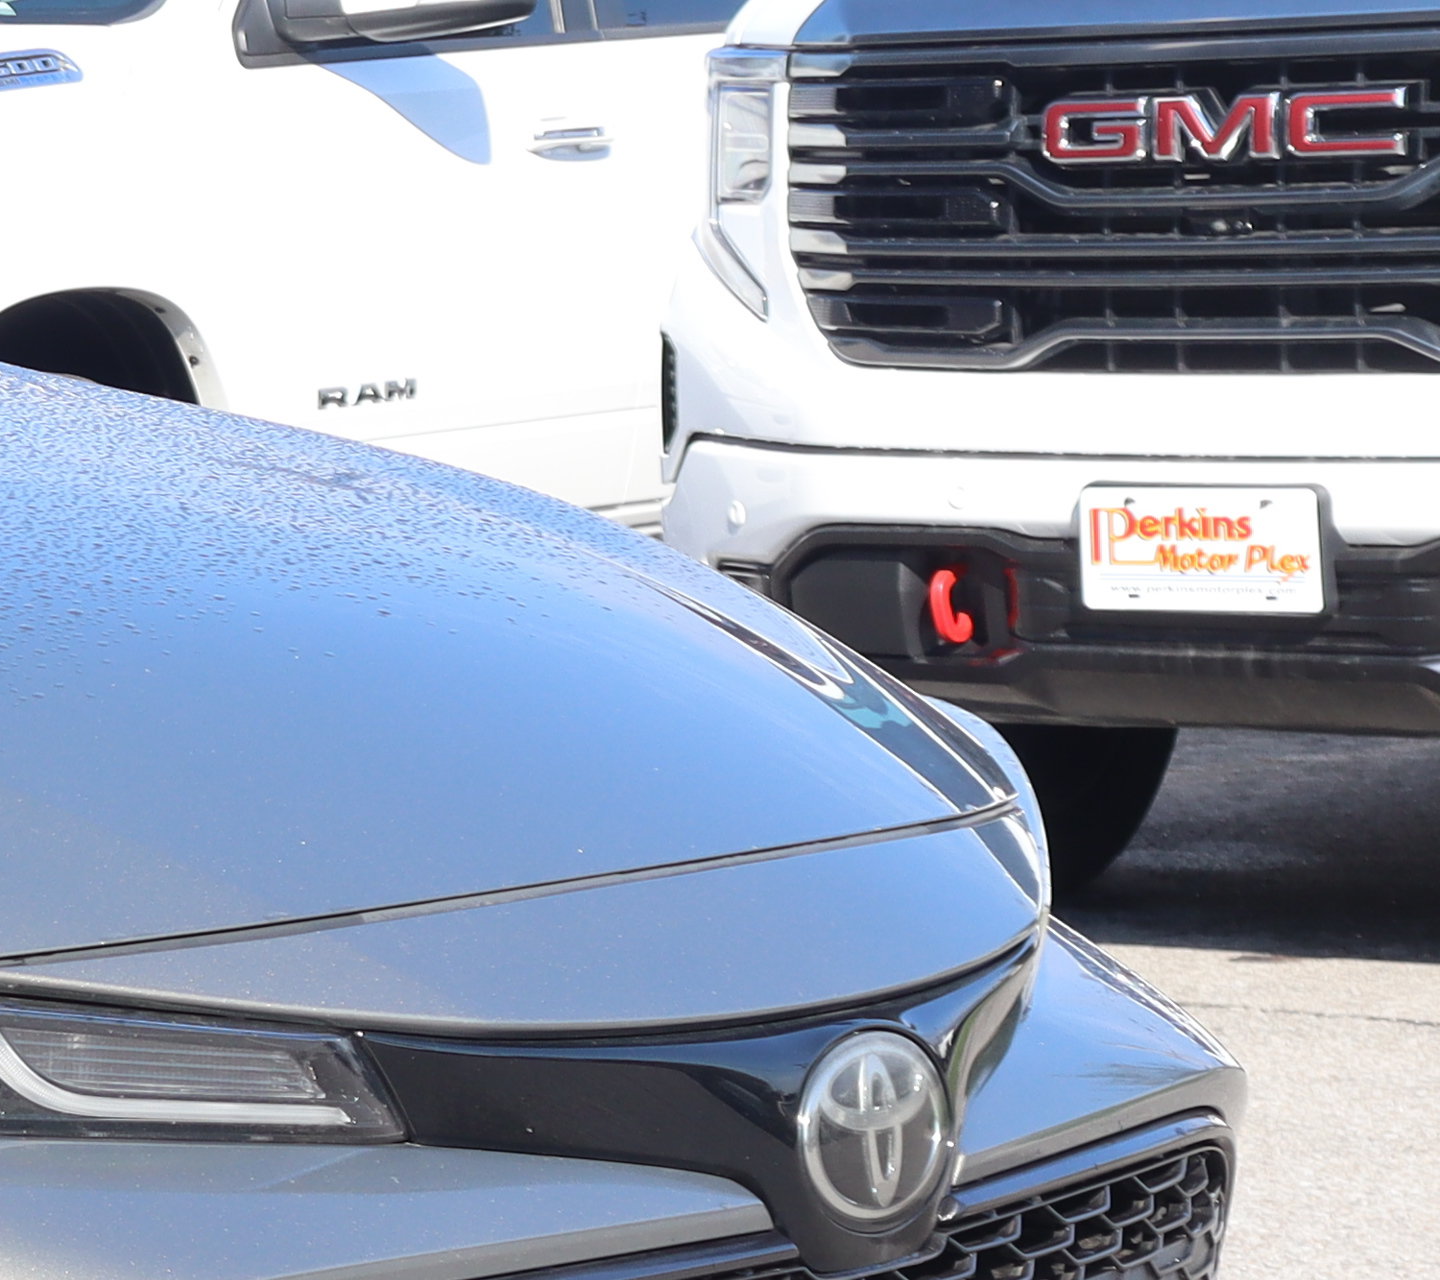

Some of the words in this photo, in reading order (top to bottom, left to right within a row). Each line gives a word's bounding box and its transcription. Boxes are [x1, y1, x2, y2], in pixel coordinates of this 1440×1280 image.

[1041, 85, 1408, 164] GMC
[317, 378, 418, 410] RAM
[1089, 507, 1253, 566] Perkins
[1155, 544, 1239, 575] Motor
[1245, 545, 1311, 584] Plex
